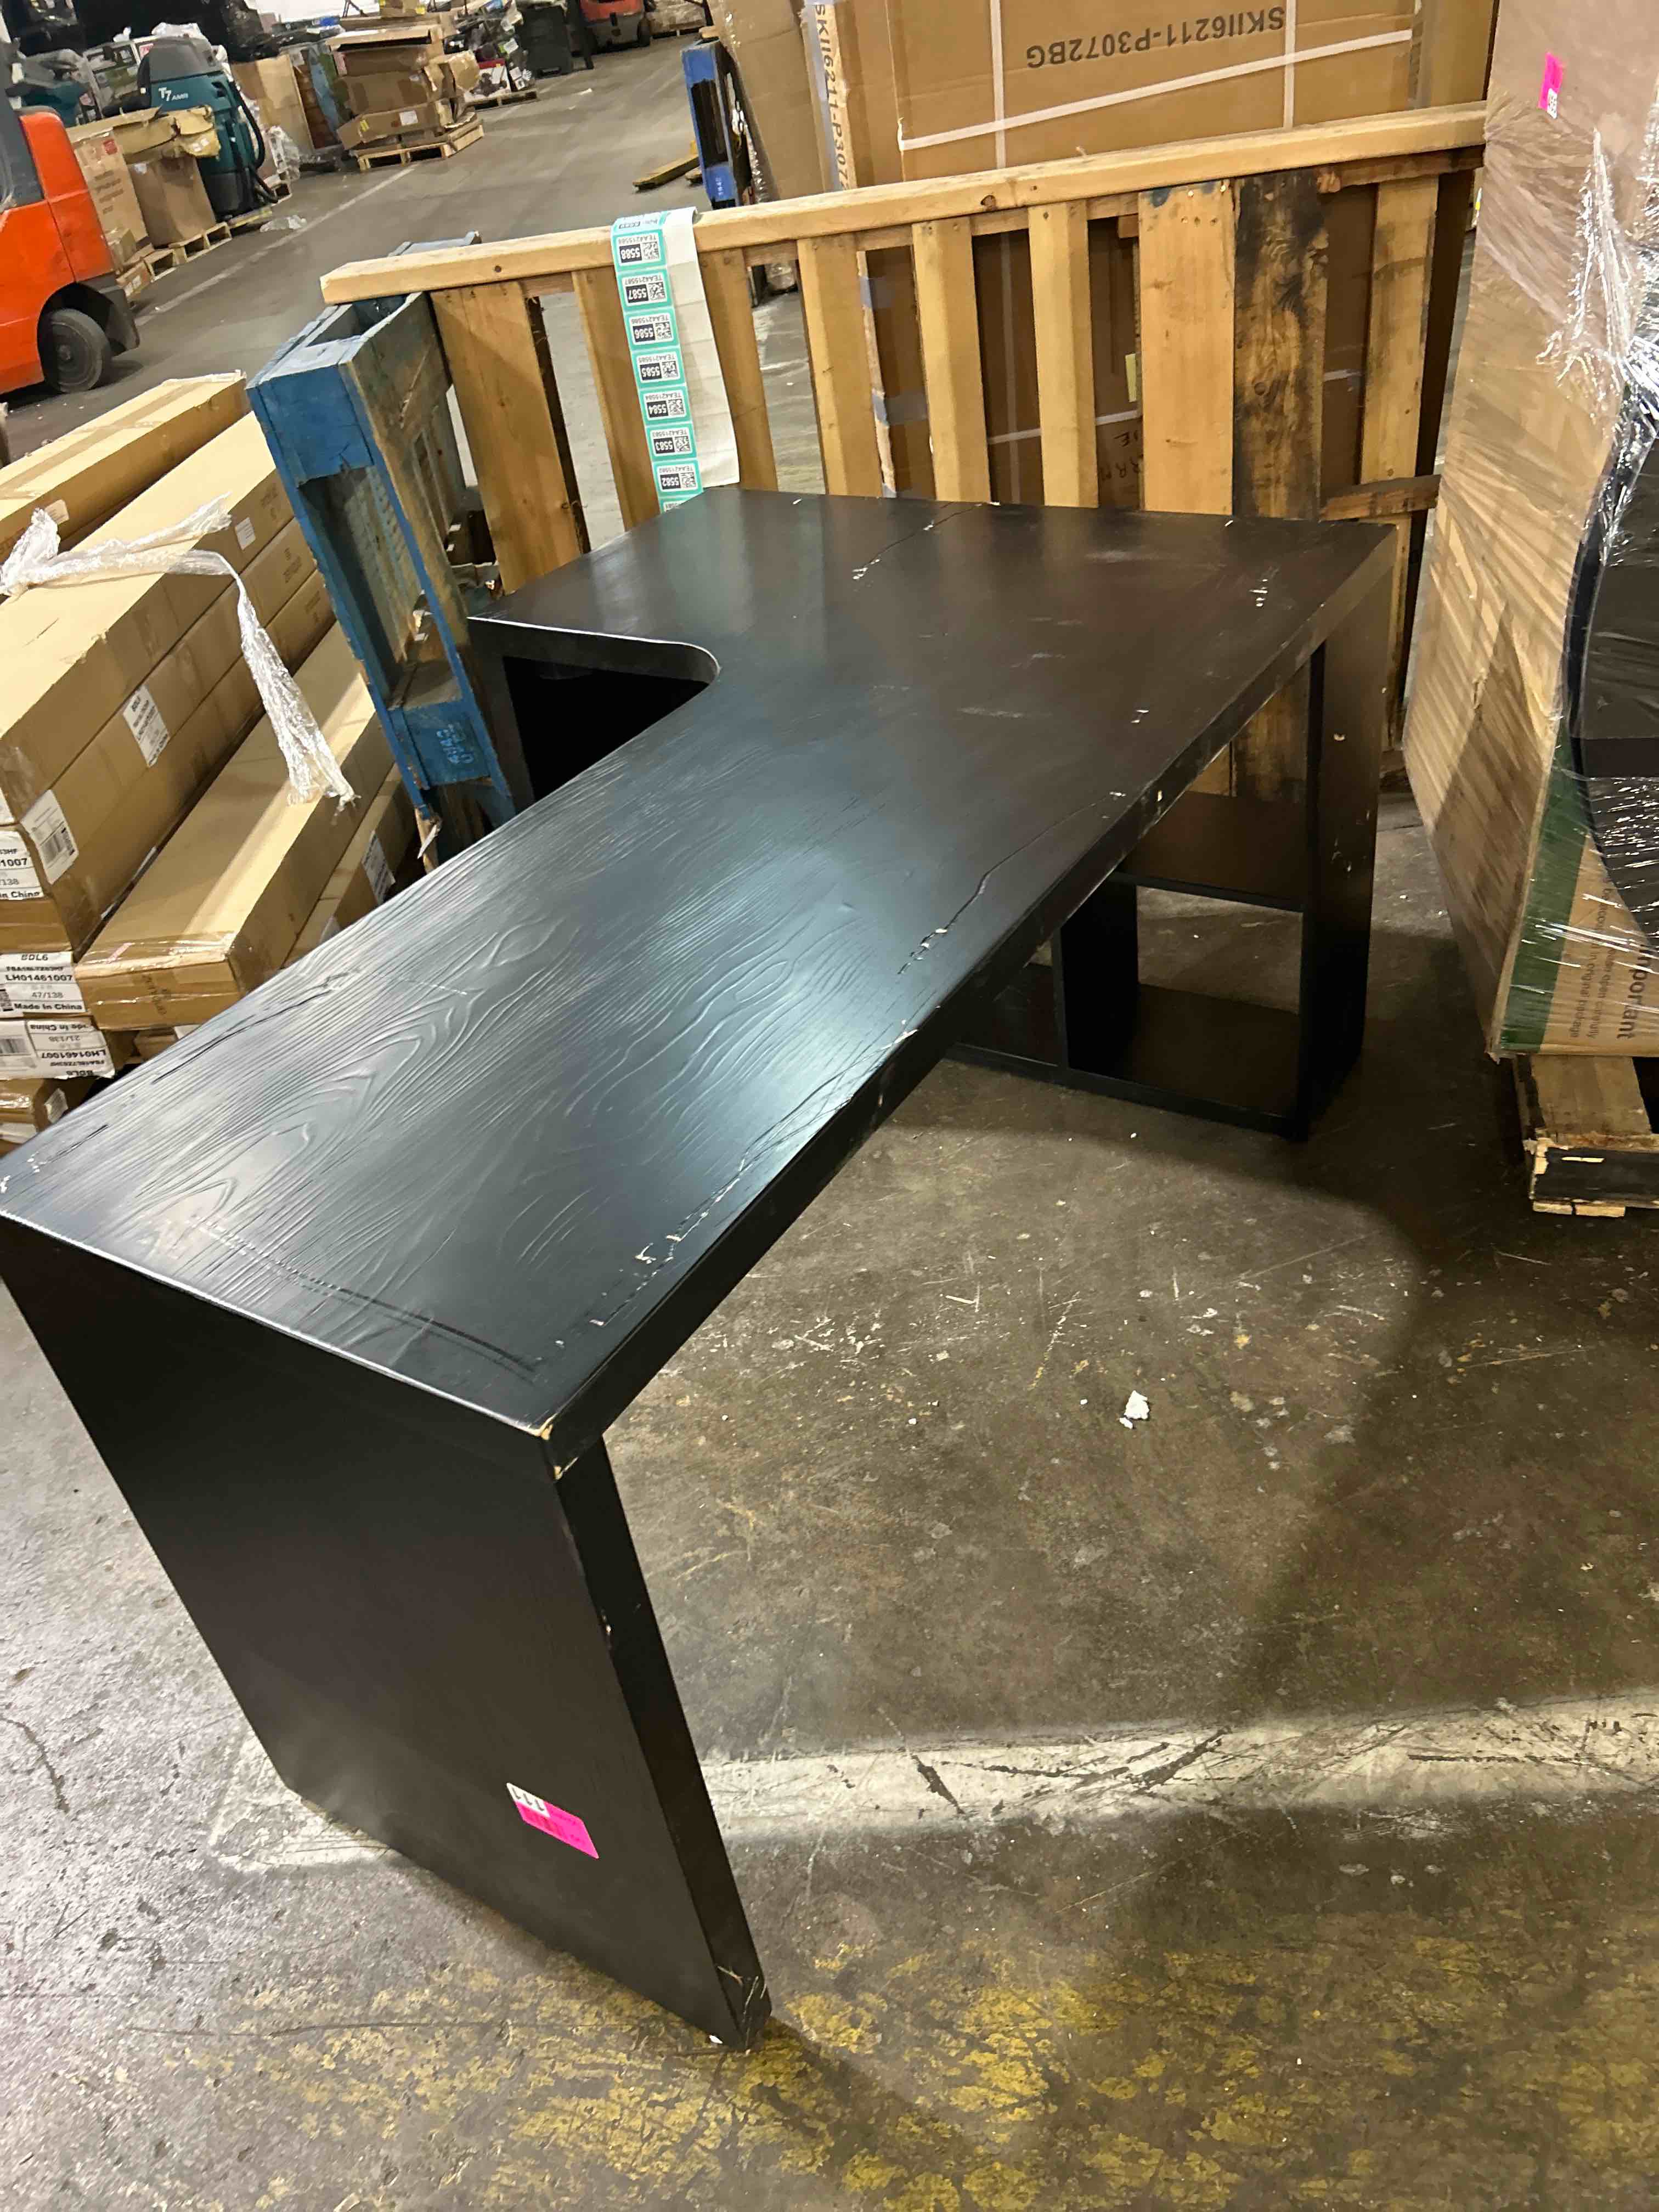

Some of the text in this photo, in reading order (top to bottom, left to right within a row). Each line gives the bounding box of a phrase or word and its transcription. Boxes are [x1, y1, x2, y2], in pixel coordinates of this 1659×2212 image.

[620, 247, 641, 260] 5588
[628, 288, 647, 300] 5587
[634, 327, 654, 339] 5586
[641, 366, 661, 378] 5585
[648, 404, 667, 415] 5584
[655, 441, 673, 452] 5583
[661, 477, 679, 487] 5582
